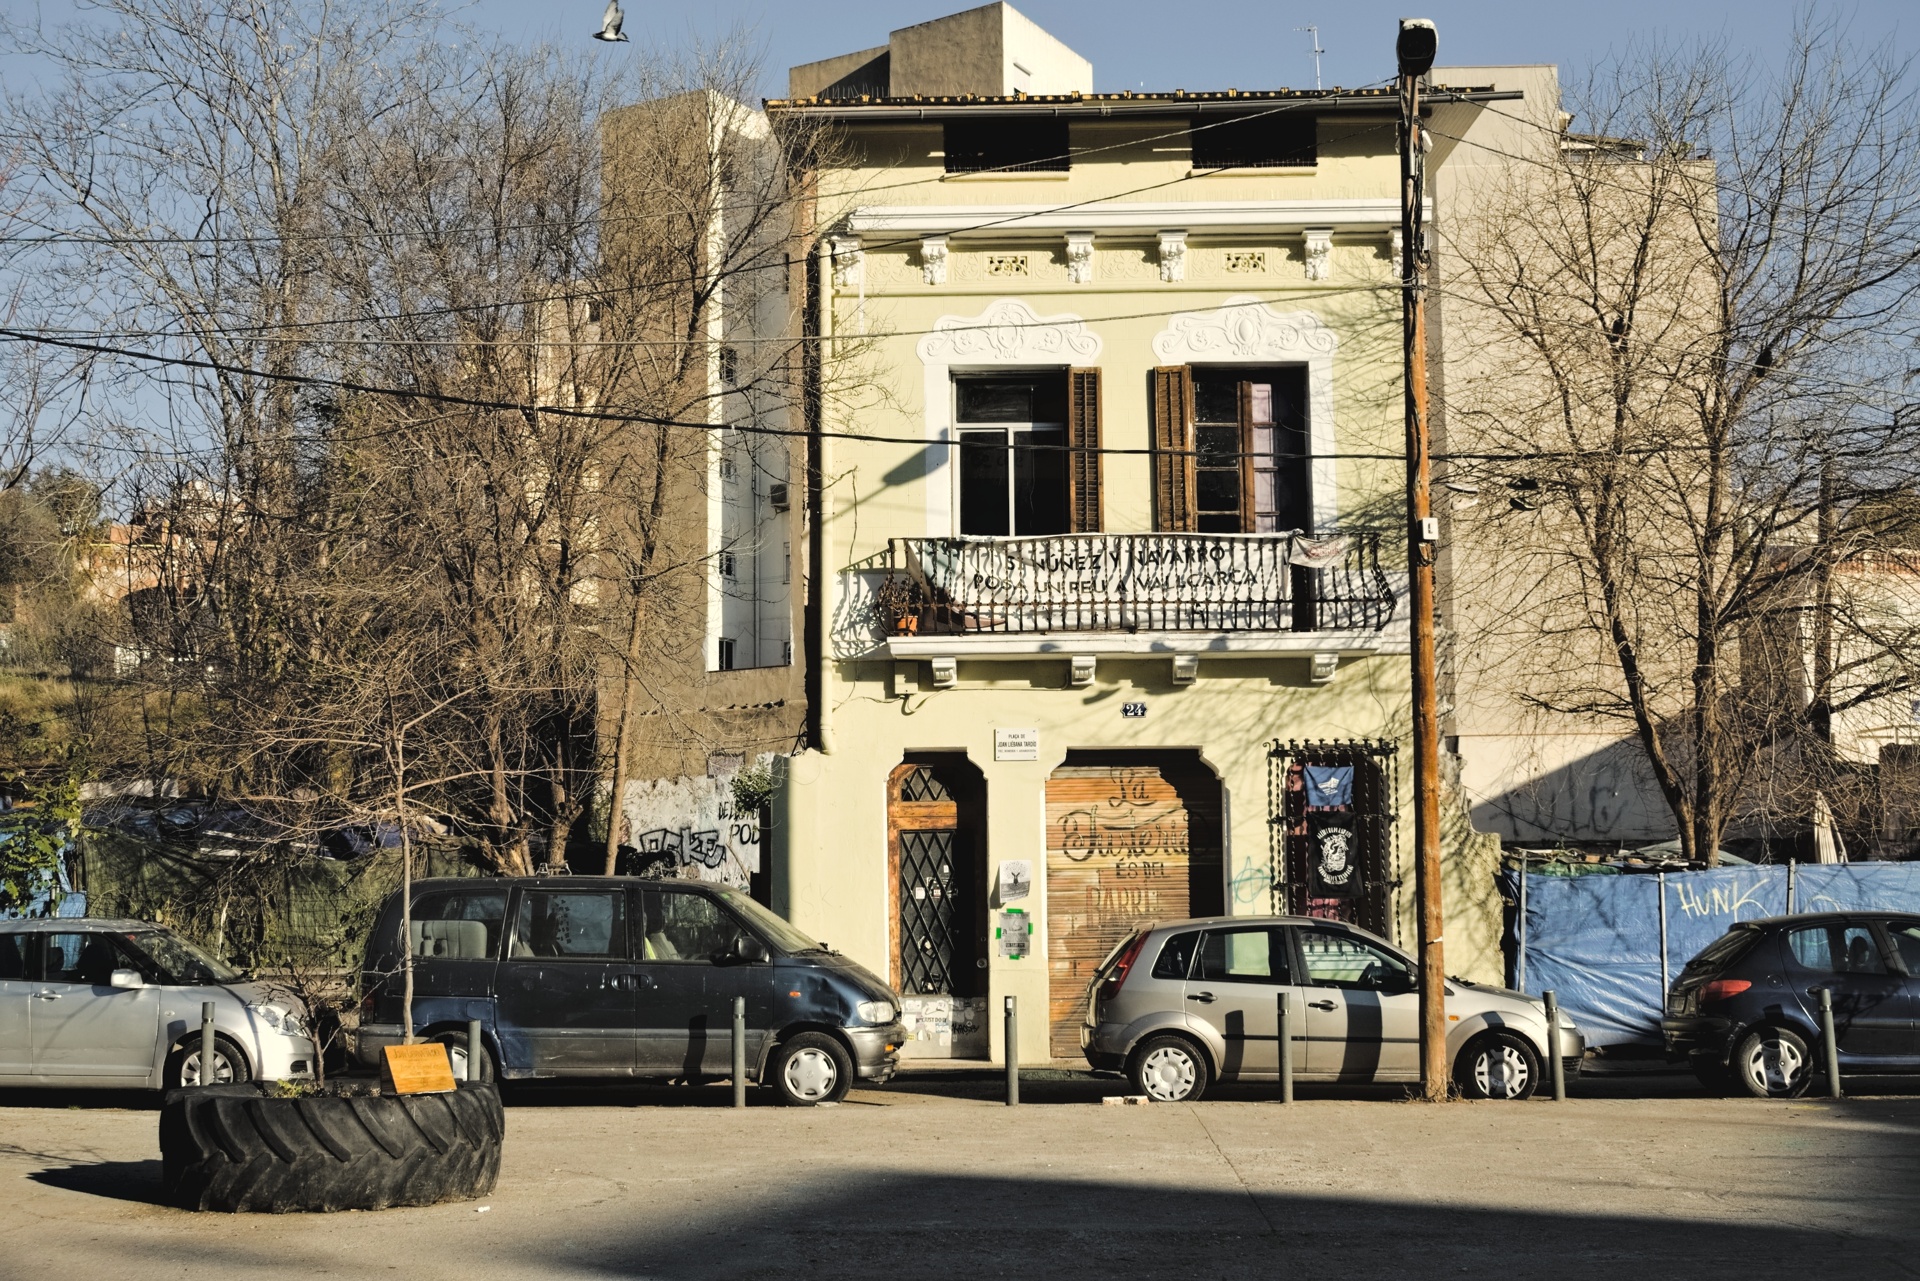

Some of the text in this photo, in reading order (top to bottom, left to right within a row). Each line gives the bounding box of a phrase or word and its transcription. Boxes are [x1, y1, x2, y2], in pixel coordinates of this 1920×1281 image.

[1110, 552, 1121, 567] Y
[1133, 546, 1225, 567] NAVARRO
[1137, 569, 1258, 592] VALLCARCA
[1126, 704, 1144, 716] 24
[1676, 879, 1773, 923] HUNK
